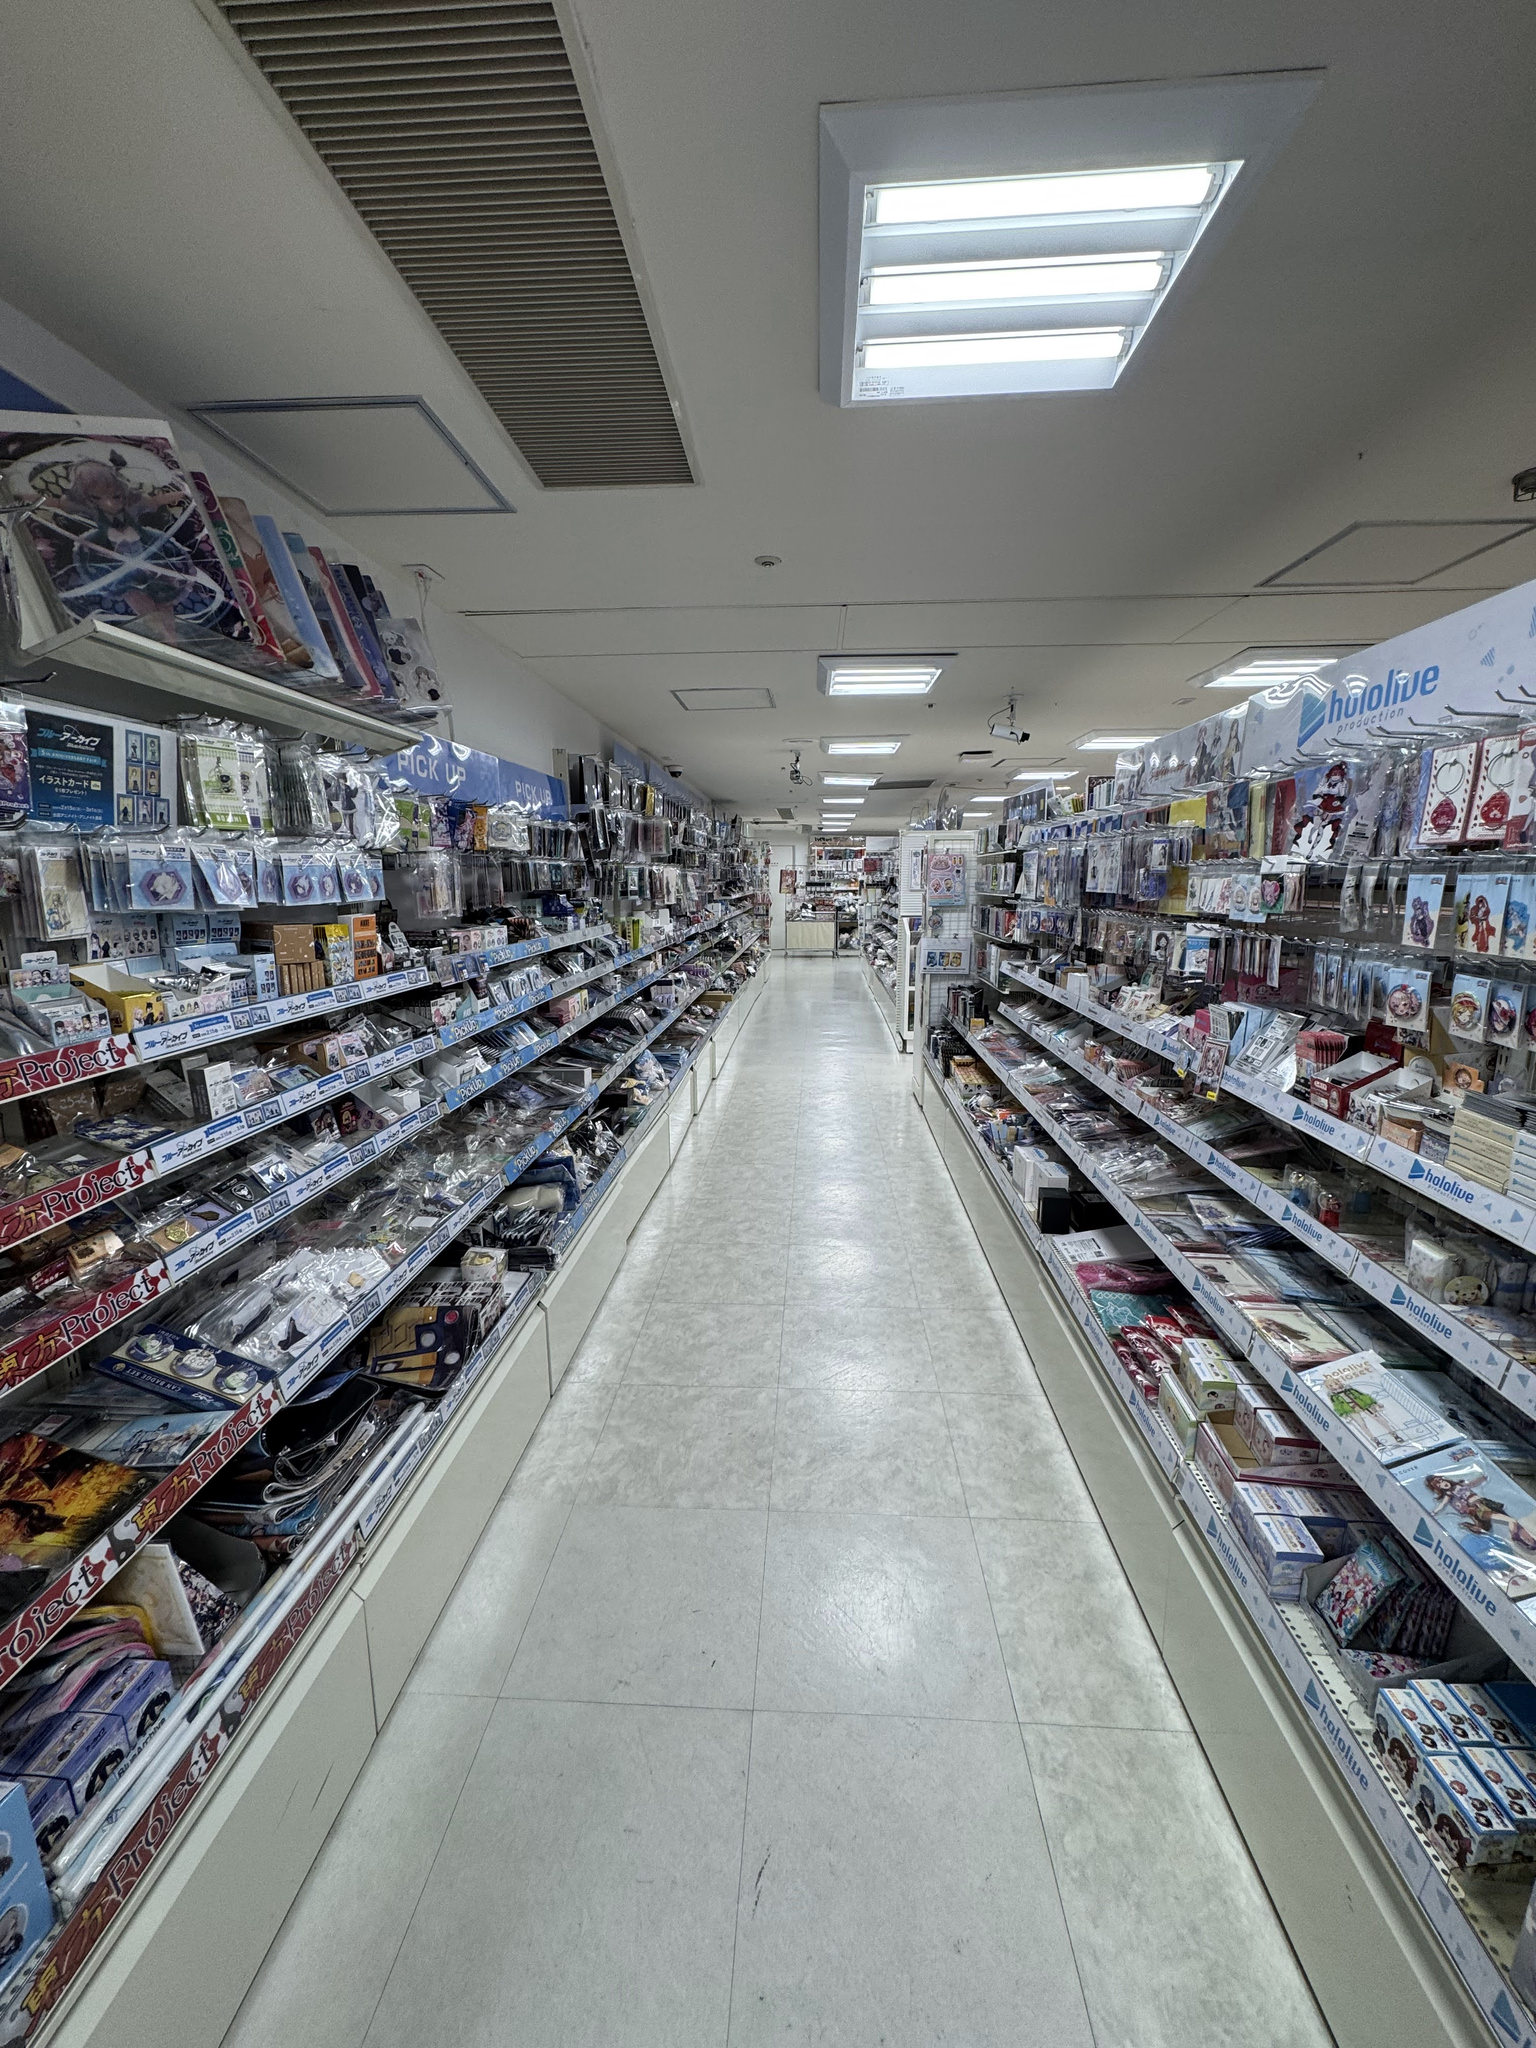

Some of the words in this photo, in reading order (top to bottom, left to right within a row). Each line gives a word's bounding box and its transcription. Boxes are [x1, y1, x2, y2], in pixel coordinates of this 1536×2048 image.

[1328, 665, 1440, 724] hololive
[1336, 708, 1404, 735] production
[39, 775, 90, 788] イラストカード
[397, 751, 440, 782] PICK
[445, 762, 468, 787] UP
[514, 780, 537, 803] PICK
[455, 1022, 477, 1040] PickUp
[461, 1079, 483, 1100] PickUp
[1303, 1110, 1335, 1136] hololive
[1215, 1157, 1237, 1180] hololive
[1424, 1168, 1475, 1204] hololive
[0, 1161, 140, 1246] 方Project
[1291, 1213, 1323, 1243] hololive
[1200, 1282, 1225, 1316] hololive
[1405, 1296, 1453, 1340] hololive
[126, 1367, 142, 1377] SET
[141, 1373, 166, 1387] BADGE
[1322, 1360, 1370, 1380] hololive
[165, 1382, 183, 1393] CAN
[1292, 1384, 1330, 1432] hololive
[131, 1399, 269, 1544] 東方Project
[1215, 1531, 1248, 1589] hololive
[1433, 1539, 1497, 1617] hololive
[0, 1563, 99, 1676] roject
[1319, 1703, 1370, 1792] hololive
